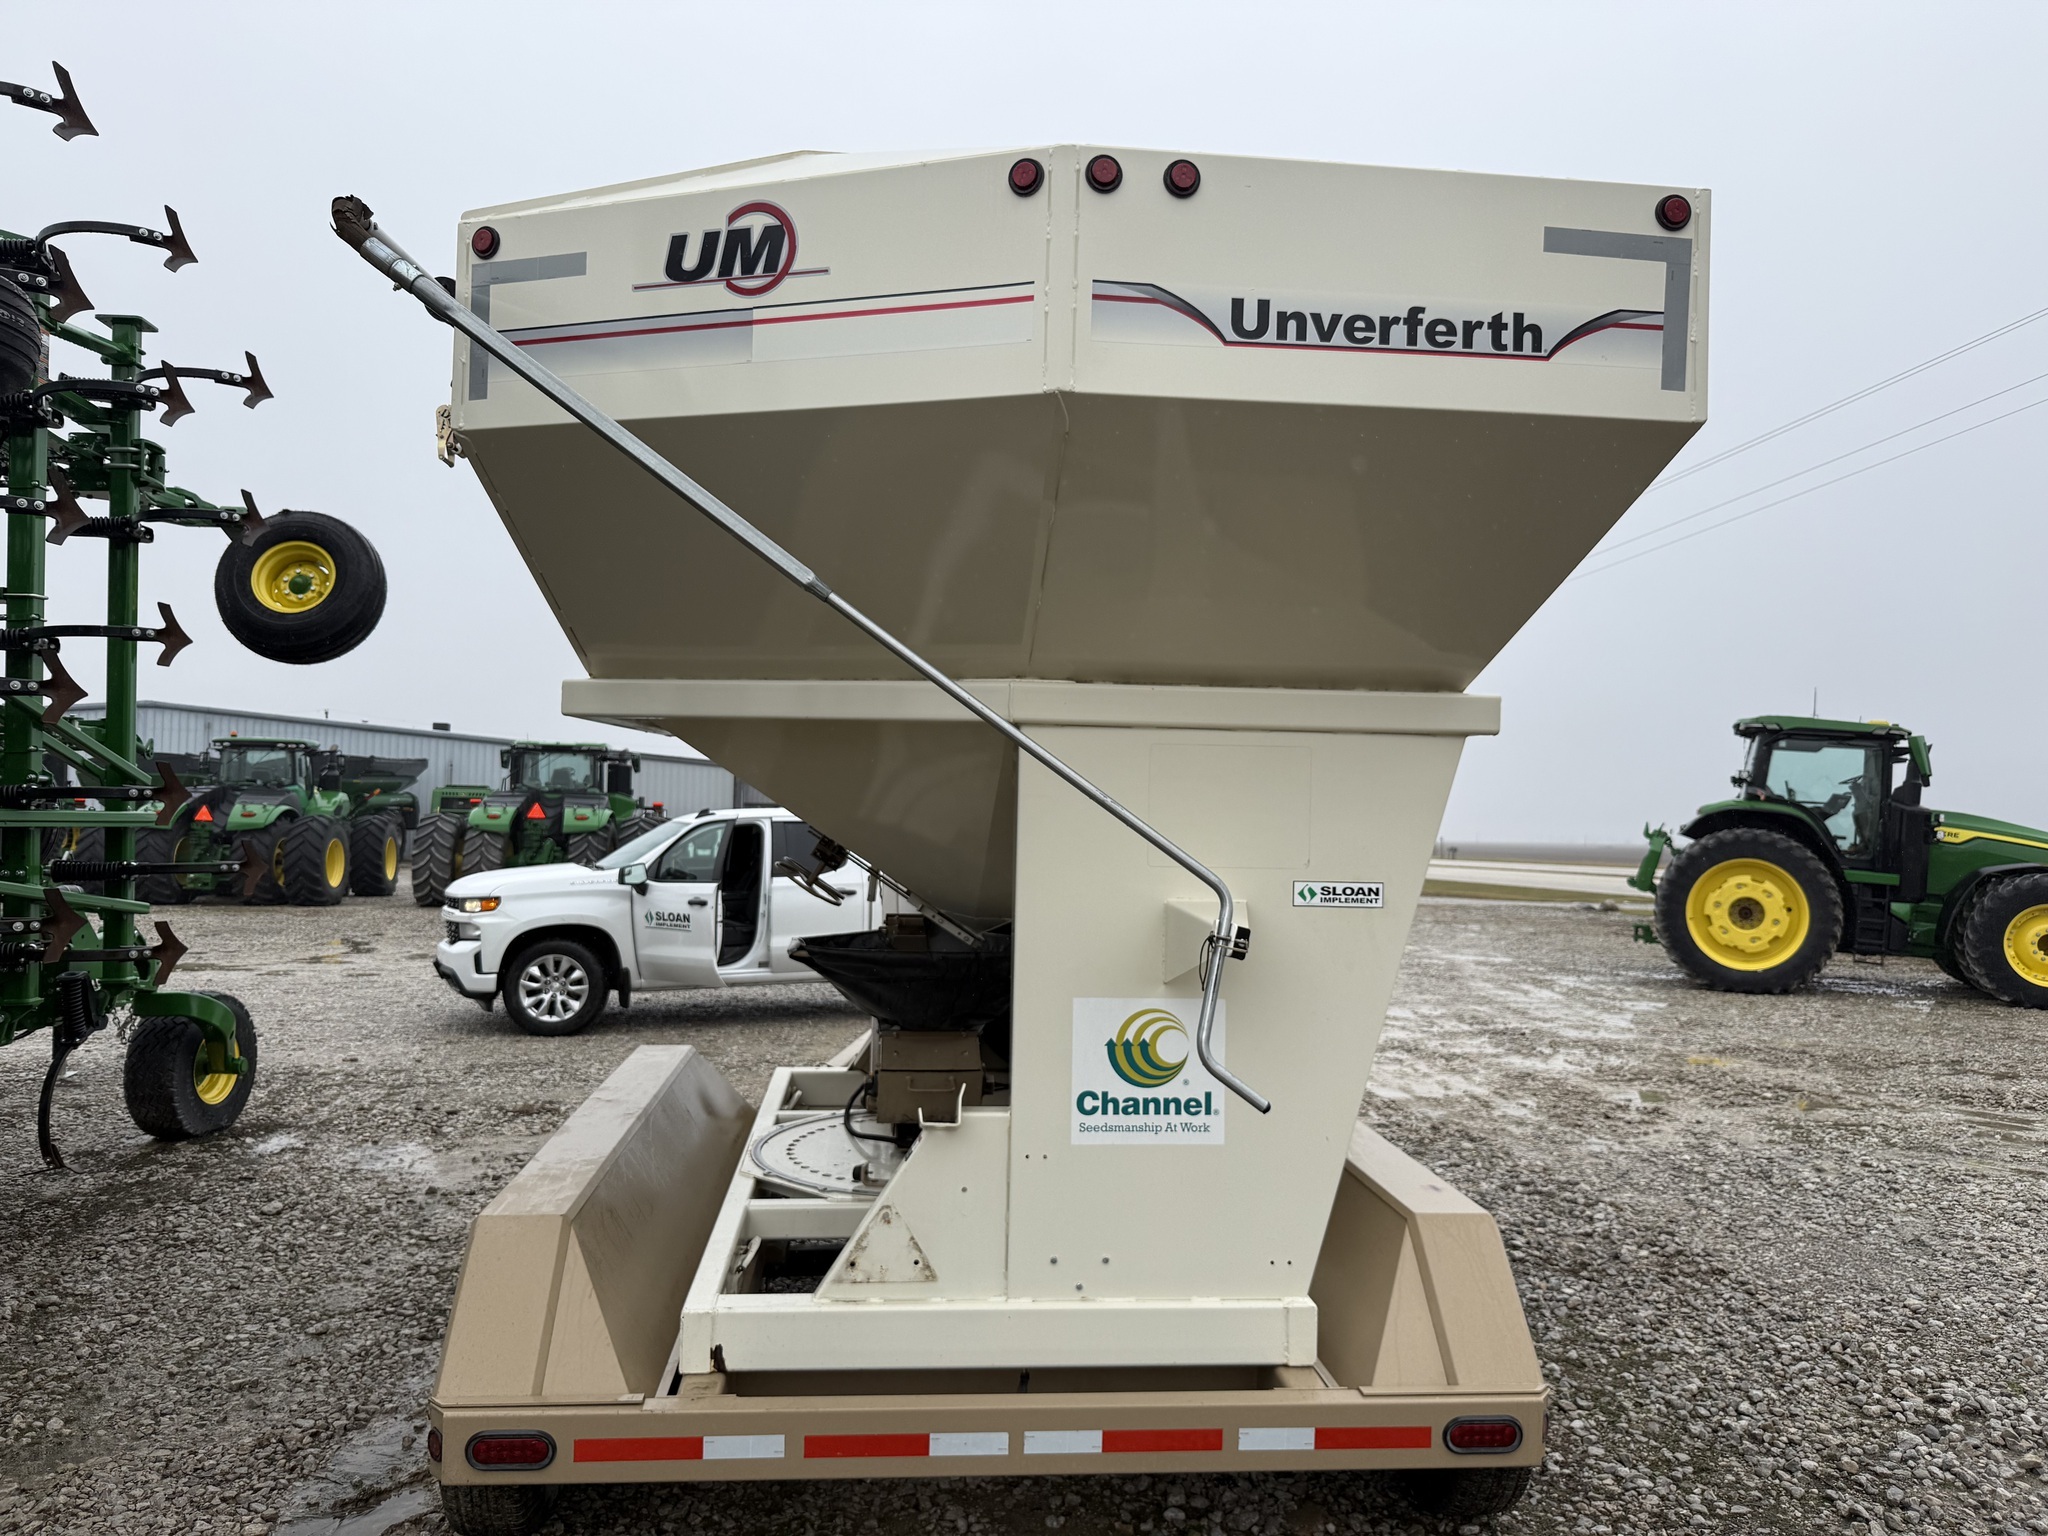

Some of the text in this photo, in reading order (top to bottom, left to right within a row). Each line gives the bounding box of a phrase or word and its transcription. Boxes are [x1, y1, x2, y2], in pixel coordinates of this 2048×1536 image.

[665, 224, 786, 282] UM
[1230, 297, 1544, 354] Unverferth
[1320, 886, 1380, 897] SLOAN
[1320, 896, 1380, 904] IMPLEMENT
[655, 911, 691, 923] SLOAN
[1079, 1122, 1210, 1135] Seedsmanship At Work
